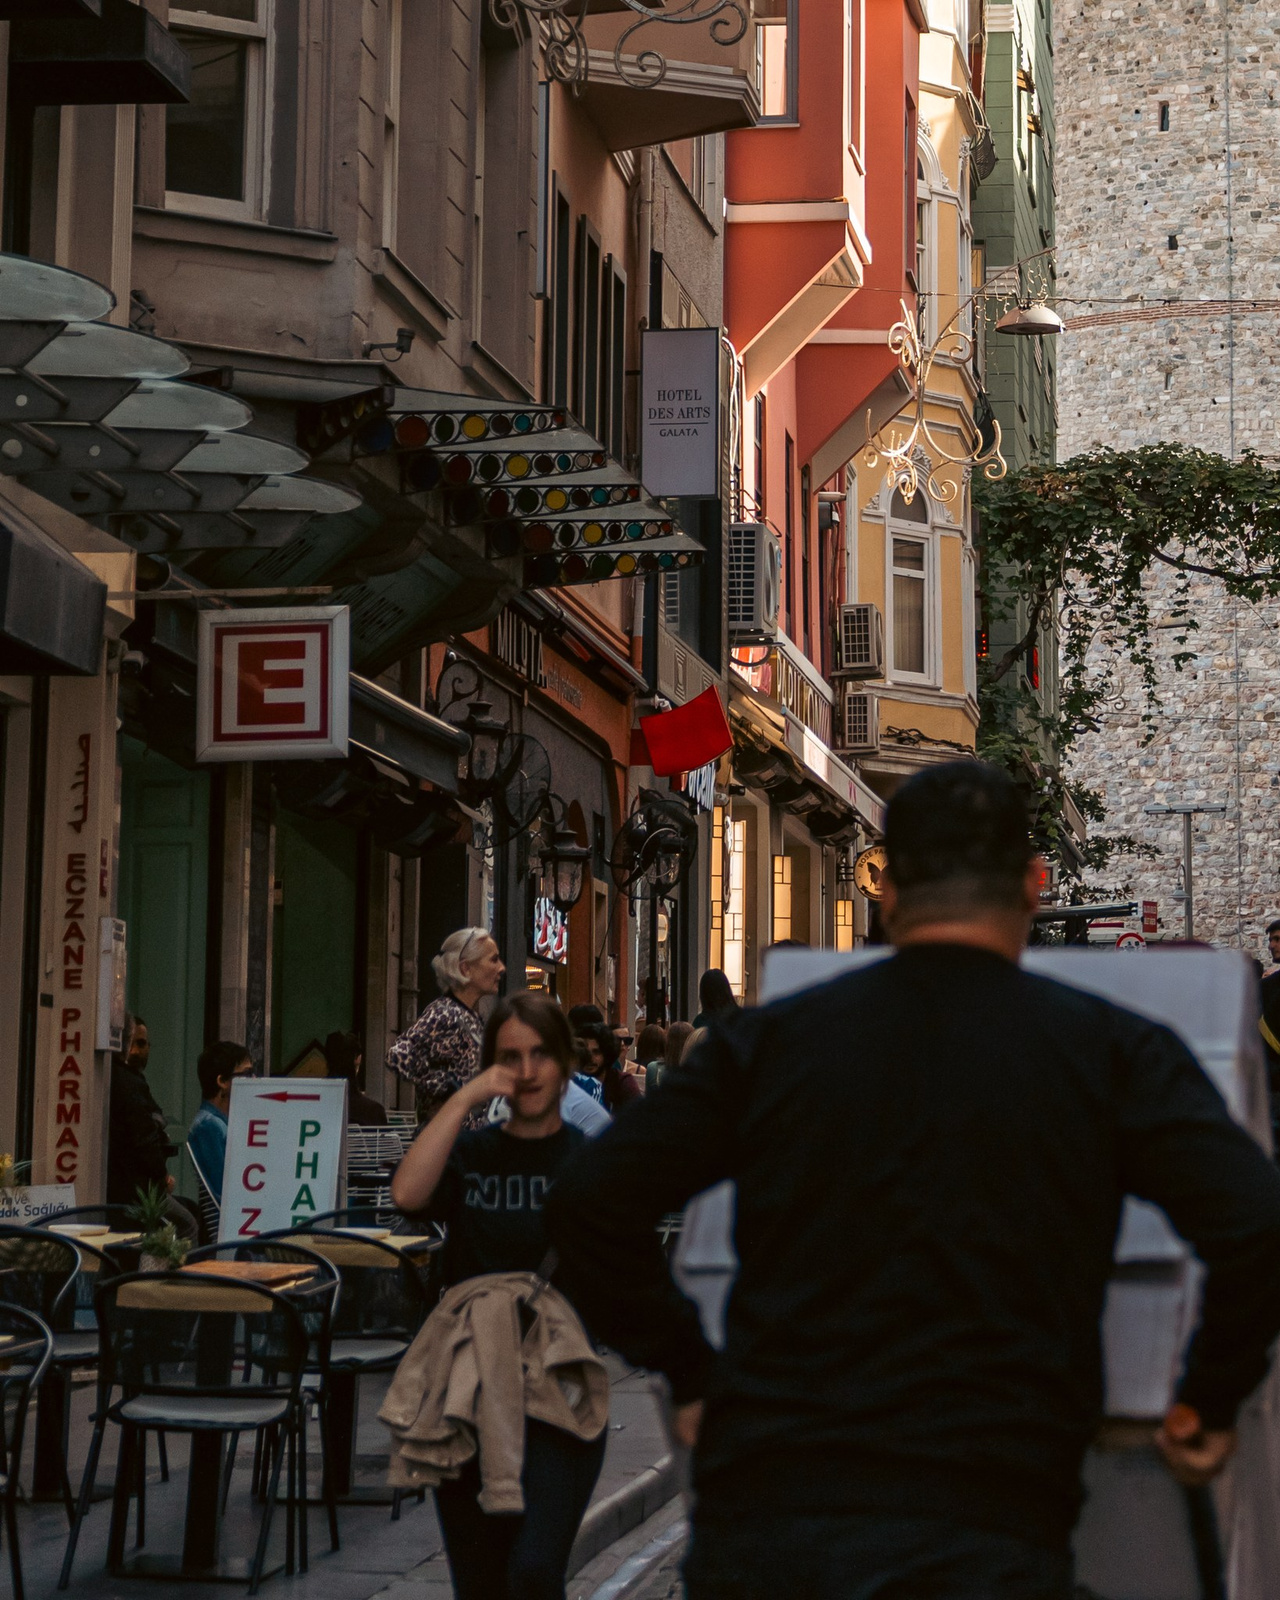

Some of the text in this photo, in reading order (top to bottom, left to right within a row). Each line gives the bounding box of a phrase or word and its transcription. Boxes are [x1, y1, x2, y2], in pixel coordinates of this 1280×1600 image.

[657, 389, 702, 401] HOTEL
[648, 406, 711, 419] DES ARTS
[660, 428, 698, 437] GALATA
[237, 640, 306, 726] E
[858, 851, 873, 868] ROSE
[62, 853, 87, 990] ECZANE
[238, 1120, 269, 1237] ECZ
